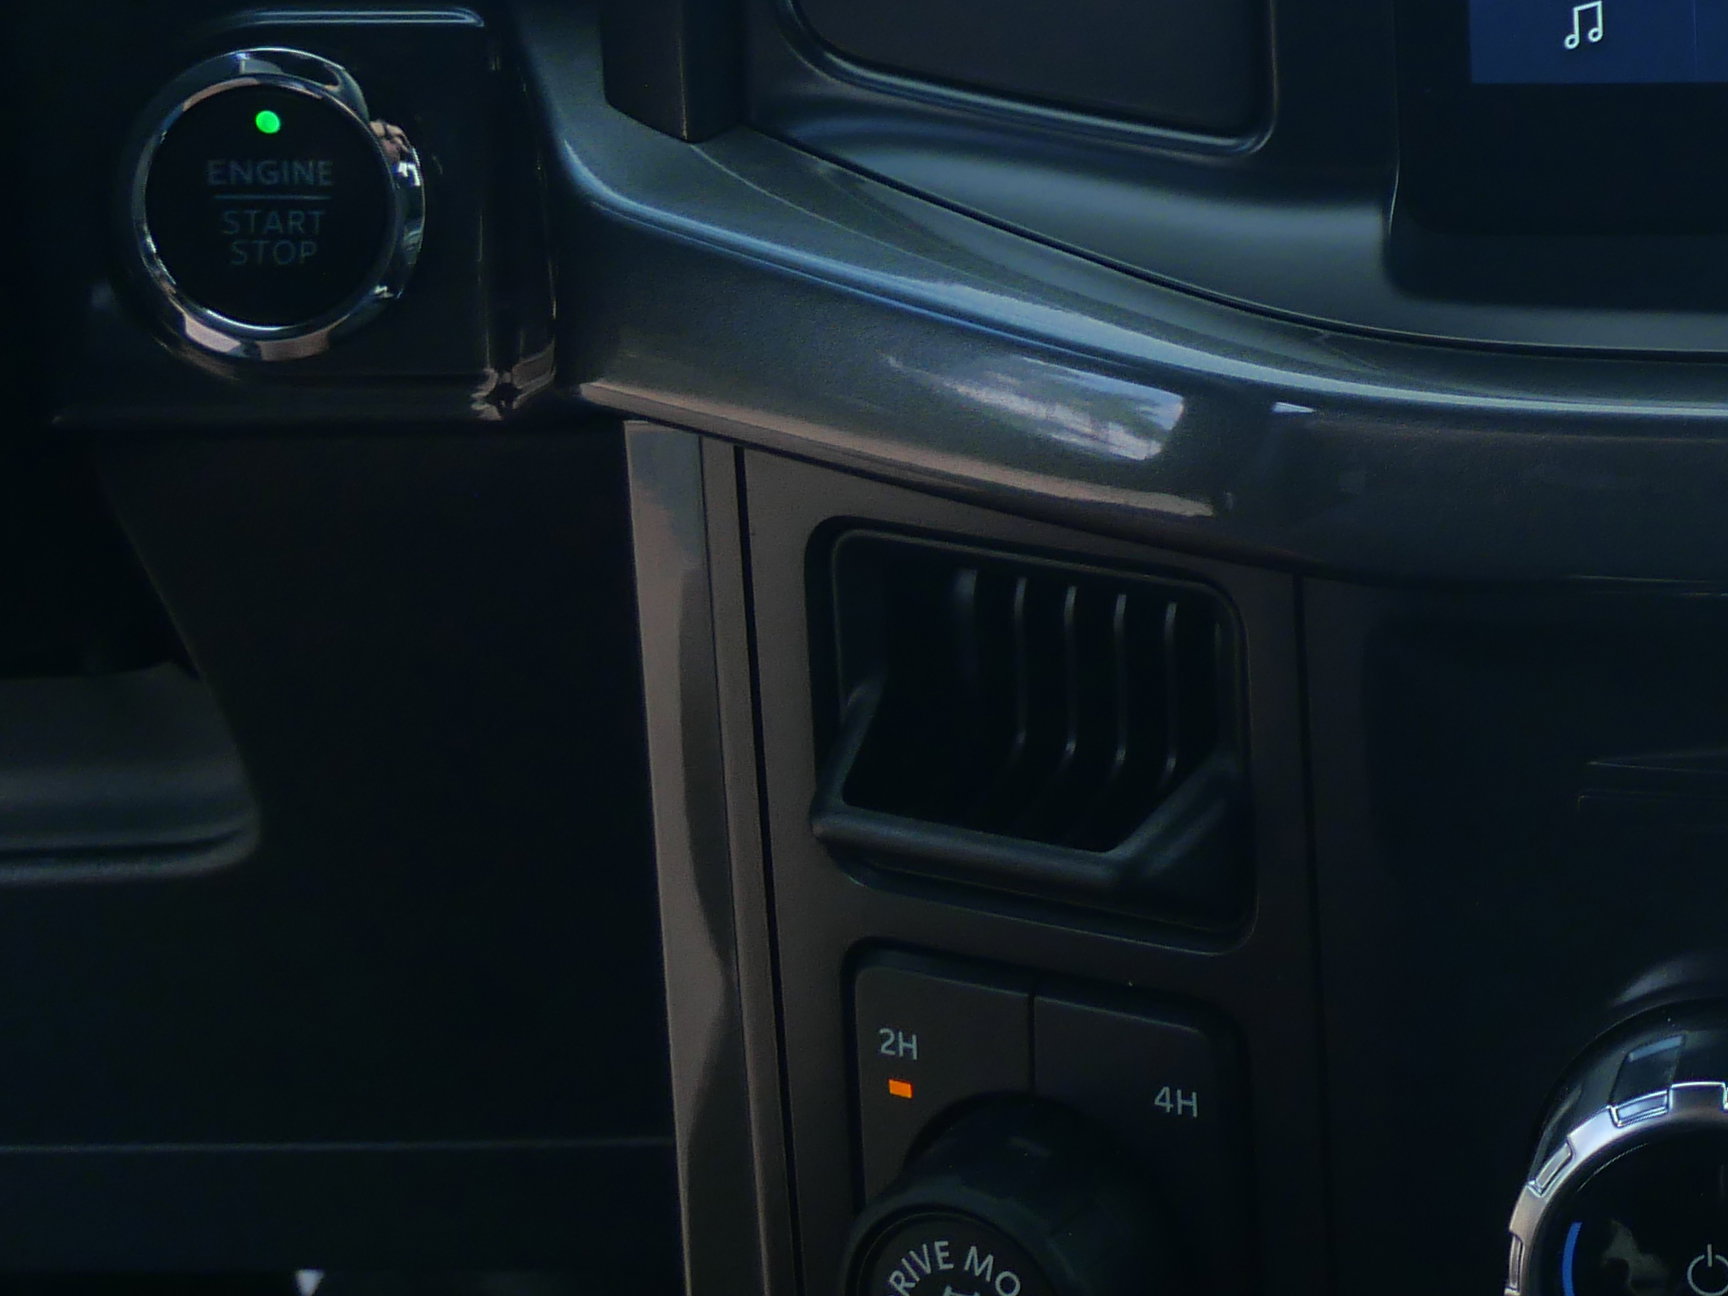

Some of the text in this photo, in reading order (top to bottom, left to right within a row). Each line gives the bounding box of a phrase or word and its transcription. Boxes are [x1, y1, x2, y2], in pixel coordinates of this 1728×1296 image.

[206, 158, 334, 188] ENGINE
[223, 208, 324, 236] START
[231, 238, 317, 266] STOP
[878, 1027, 918, 1061] 2H
[1153, 1085, 1198, 1118] 4H
[886, 1240, 1021, 1296] RIVE MO
